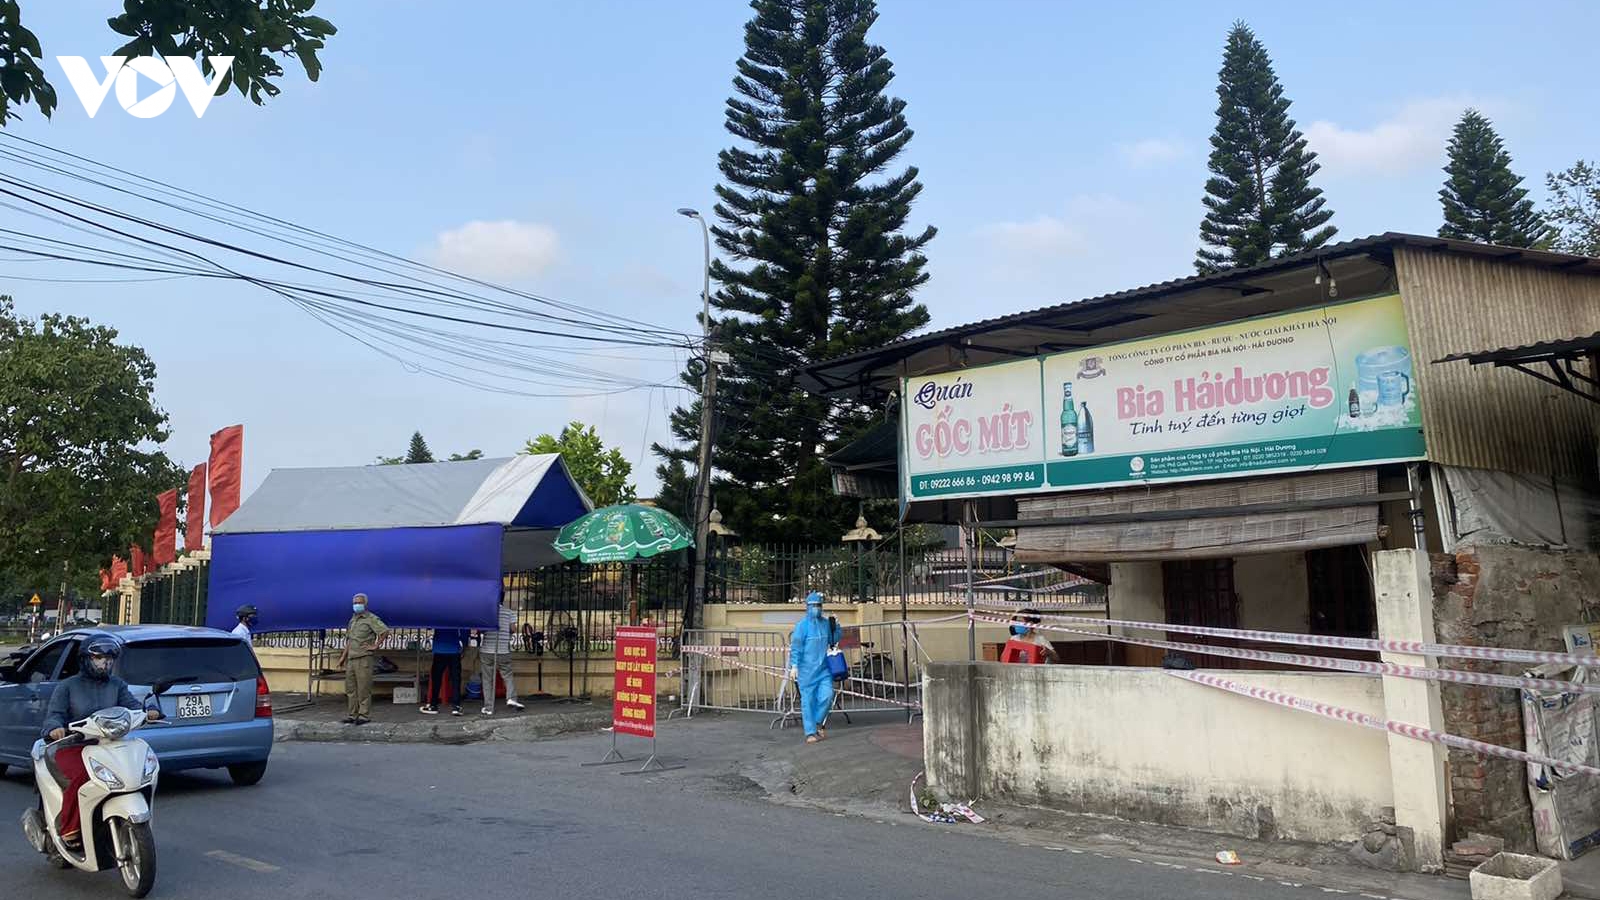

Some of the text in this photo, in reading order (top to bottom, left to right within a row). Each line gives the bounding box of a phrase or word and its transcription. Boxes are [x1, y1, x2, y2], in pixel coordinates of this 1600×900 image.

[1128, 349, 1149, 358] CÔNG
[1193, 340, 1206, 348] BIA
[1144, 357, 1164, 367] CÔNG
[1221, 345, 1231, 354] HÀ
[1233, 342, 1246, 352] NỘI
[914, 377, 973, 409] Quán
[1117, 367, 1333, 420] Bia Hảidương
[1196, 410, 1226, 428] đến
[1231, 408, 1268, 426] từng
[1272, 403, 1307, 424] giọt
[915, 403, 1032, 458] GỐC MÍT
[930, 478, 951, 489] 09222
[952, 477, 965, 487] 666
[966, 476, 976, 486] 86
[981, 474, 1000, 485] 0942
[1001, 473, 1012, 483] 98
[1012, 472, 1023, 482] 99
[1025, 471, 1035, 481] 84
[180, 705, 211, 717] 036.36
[185, 696, 203, 706] 29A
